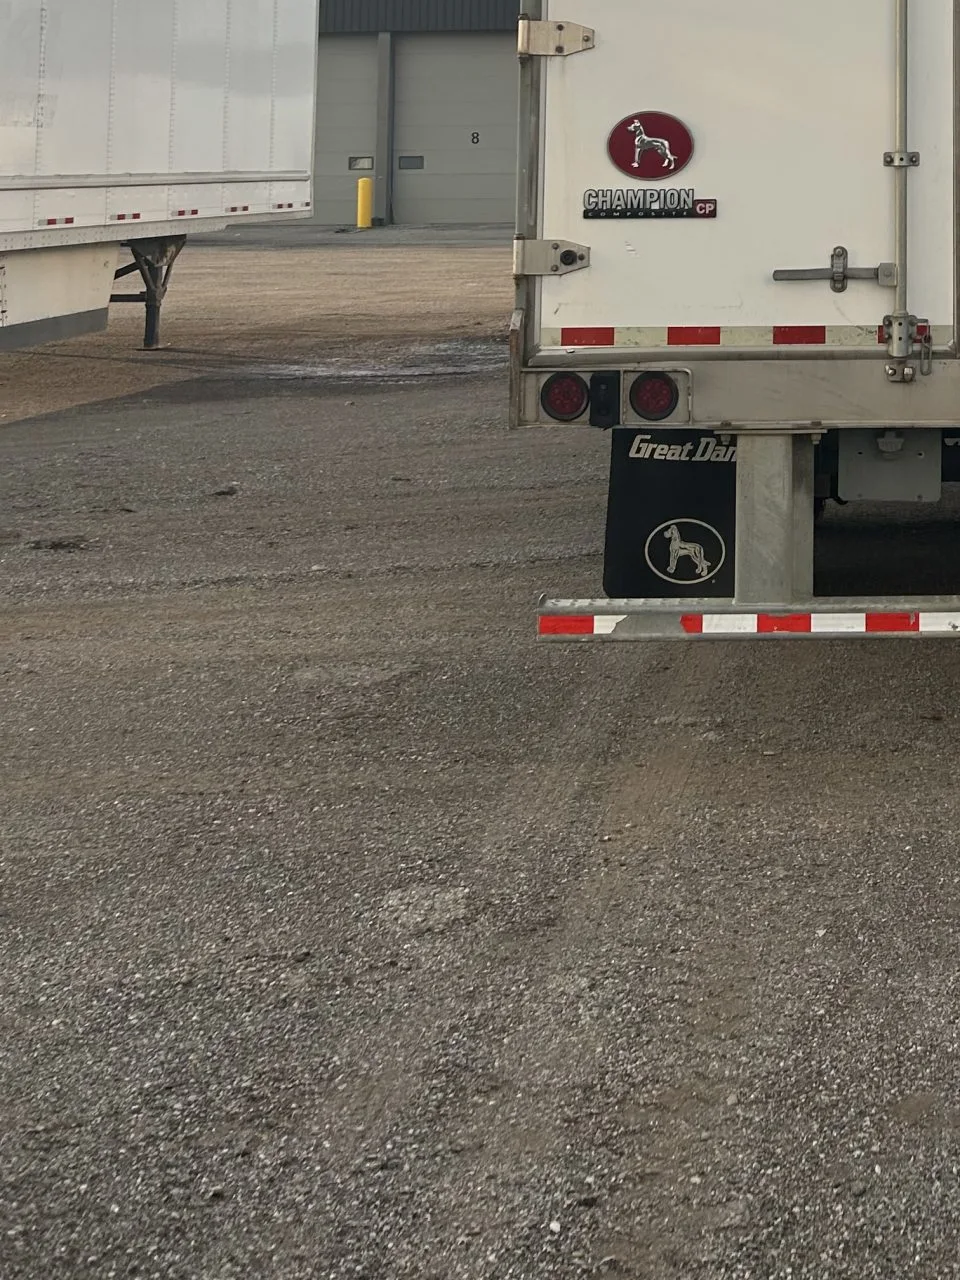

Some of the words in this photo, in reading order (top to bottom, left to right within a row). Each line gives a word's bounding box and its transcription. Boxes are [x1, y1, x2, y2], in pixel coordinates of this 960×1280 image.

[471, 131, 480, 145] 8
[583, 188, 695, 210] CHAMPION
[696, 203, 715, 214] CP
[629, 434, 693, 461] Great
[691, 437, 737, 462] Dan
